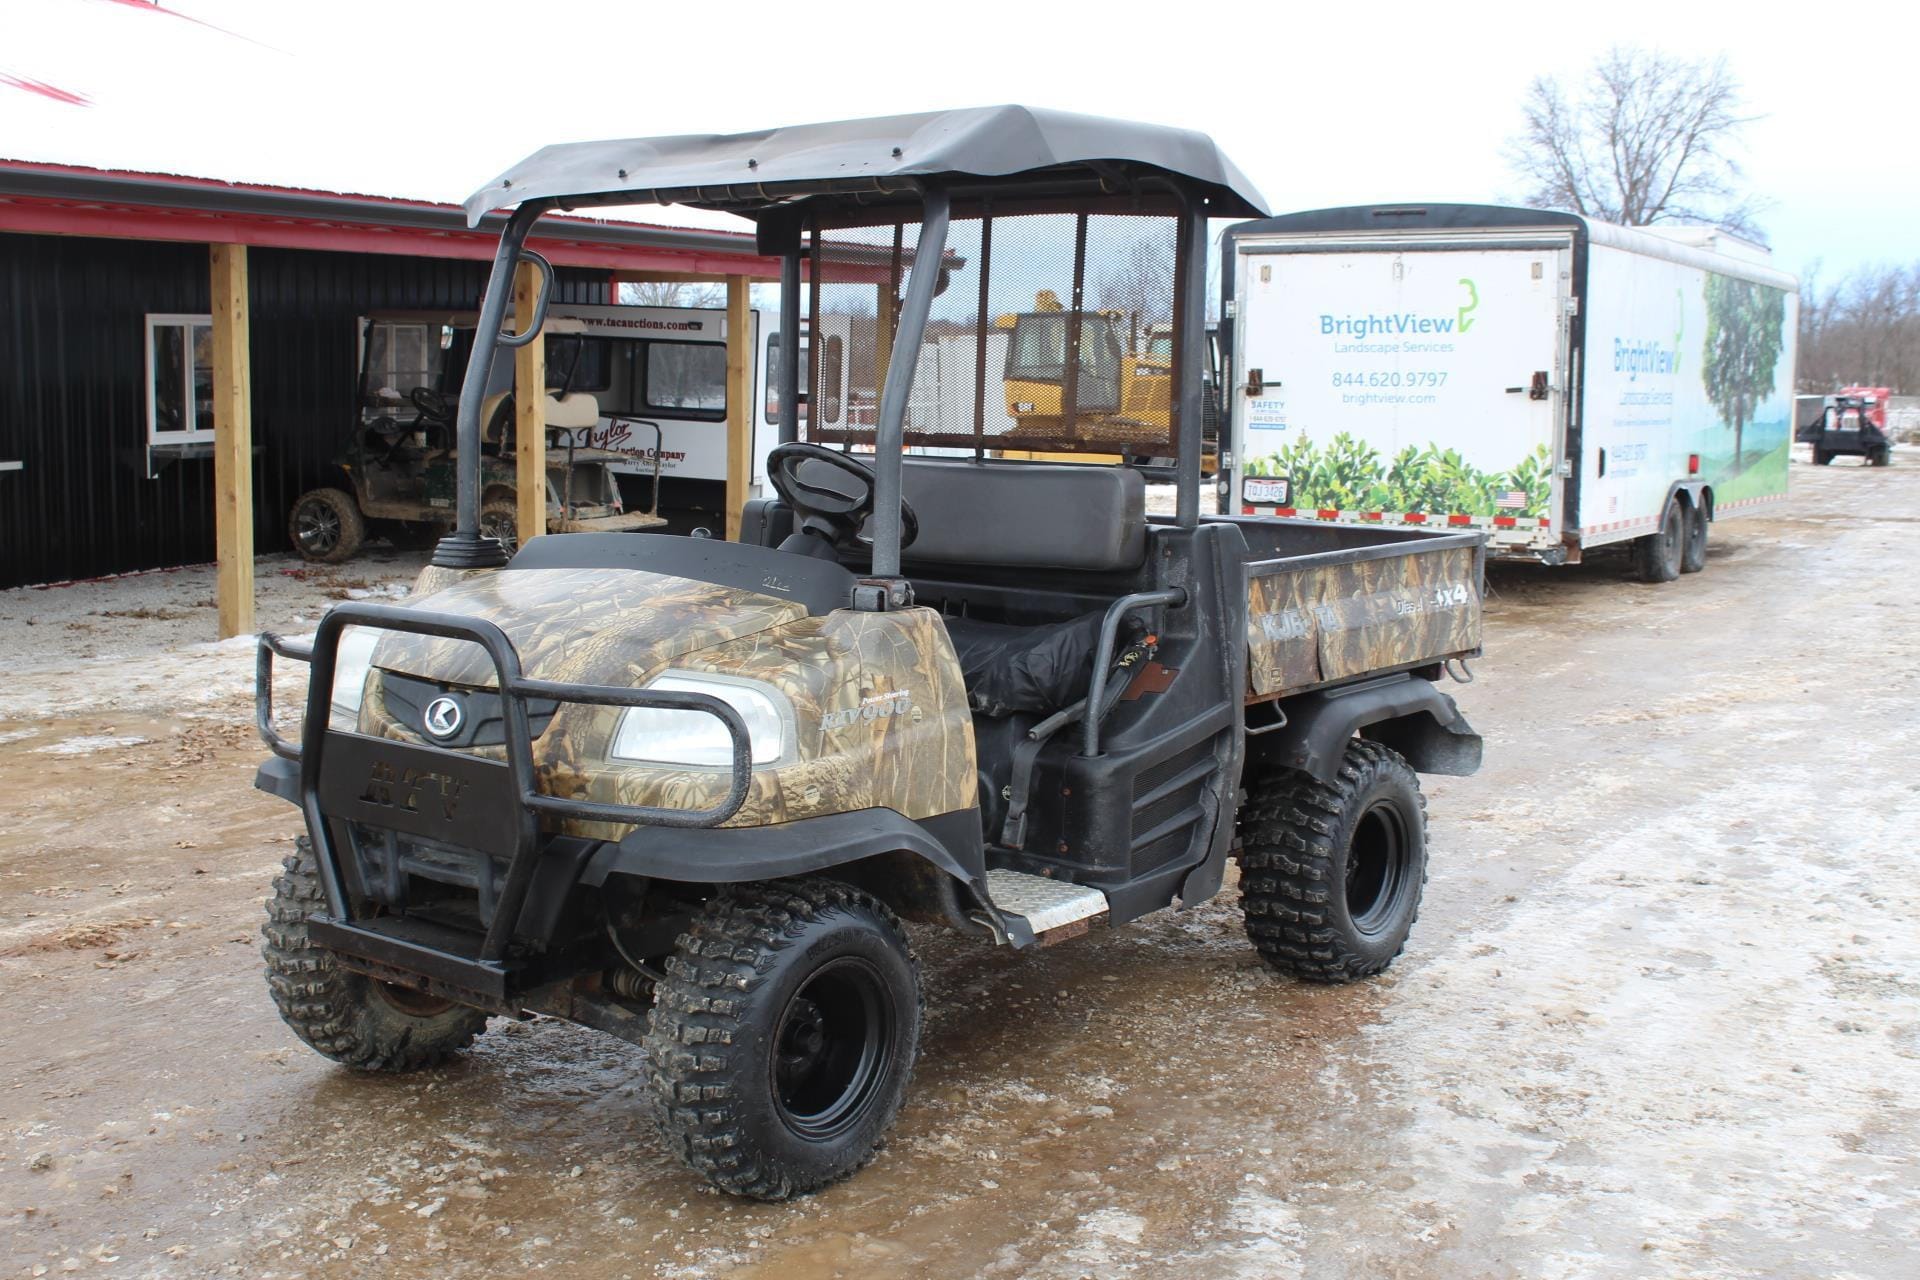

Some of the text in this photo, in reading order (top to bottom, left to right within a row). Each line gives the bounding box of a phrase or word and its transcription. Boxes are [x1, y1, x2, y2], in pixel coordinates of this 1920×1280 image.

[1320, 314, 1454, 339] BrightView
[1334, 341, 1455, 355] Landscape Services
[1614, 337, 1673, 382] BrightView
[1332, 371, 1448, 387] 844.620.9797
[1342, 393, 1436, 406] brightview.com
